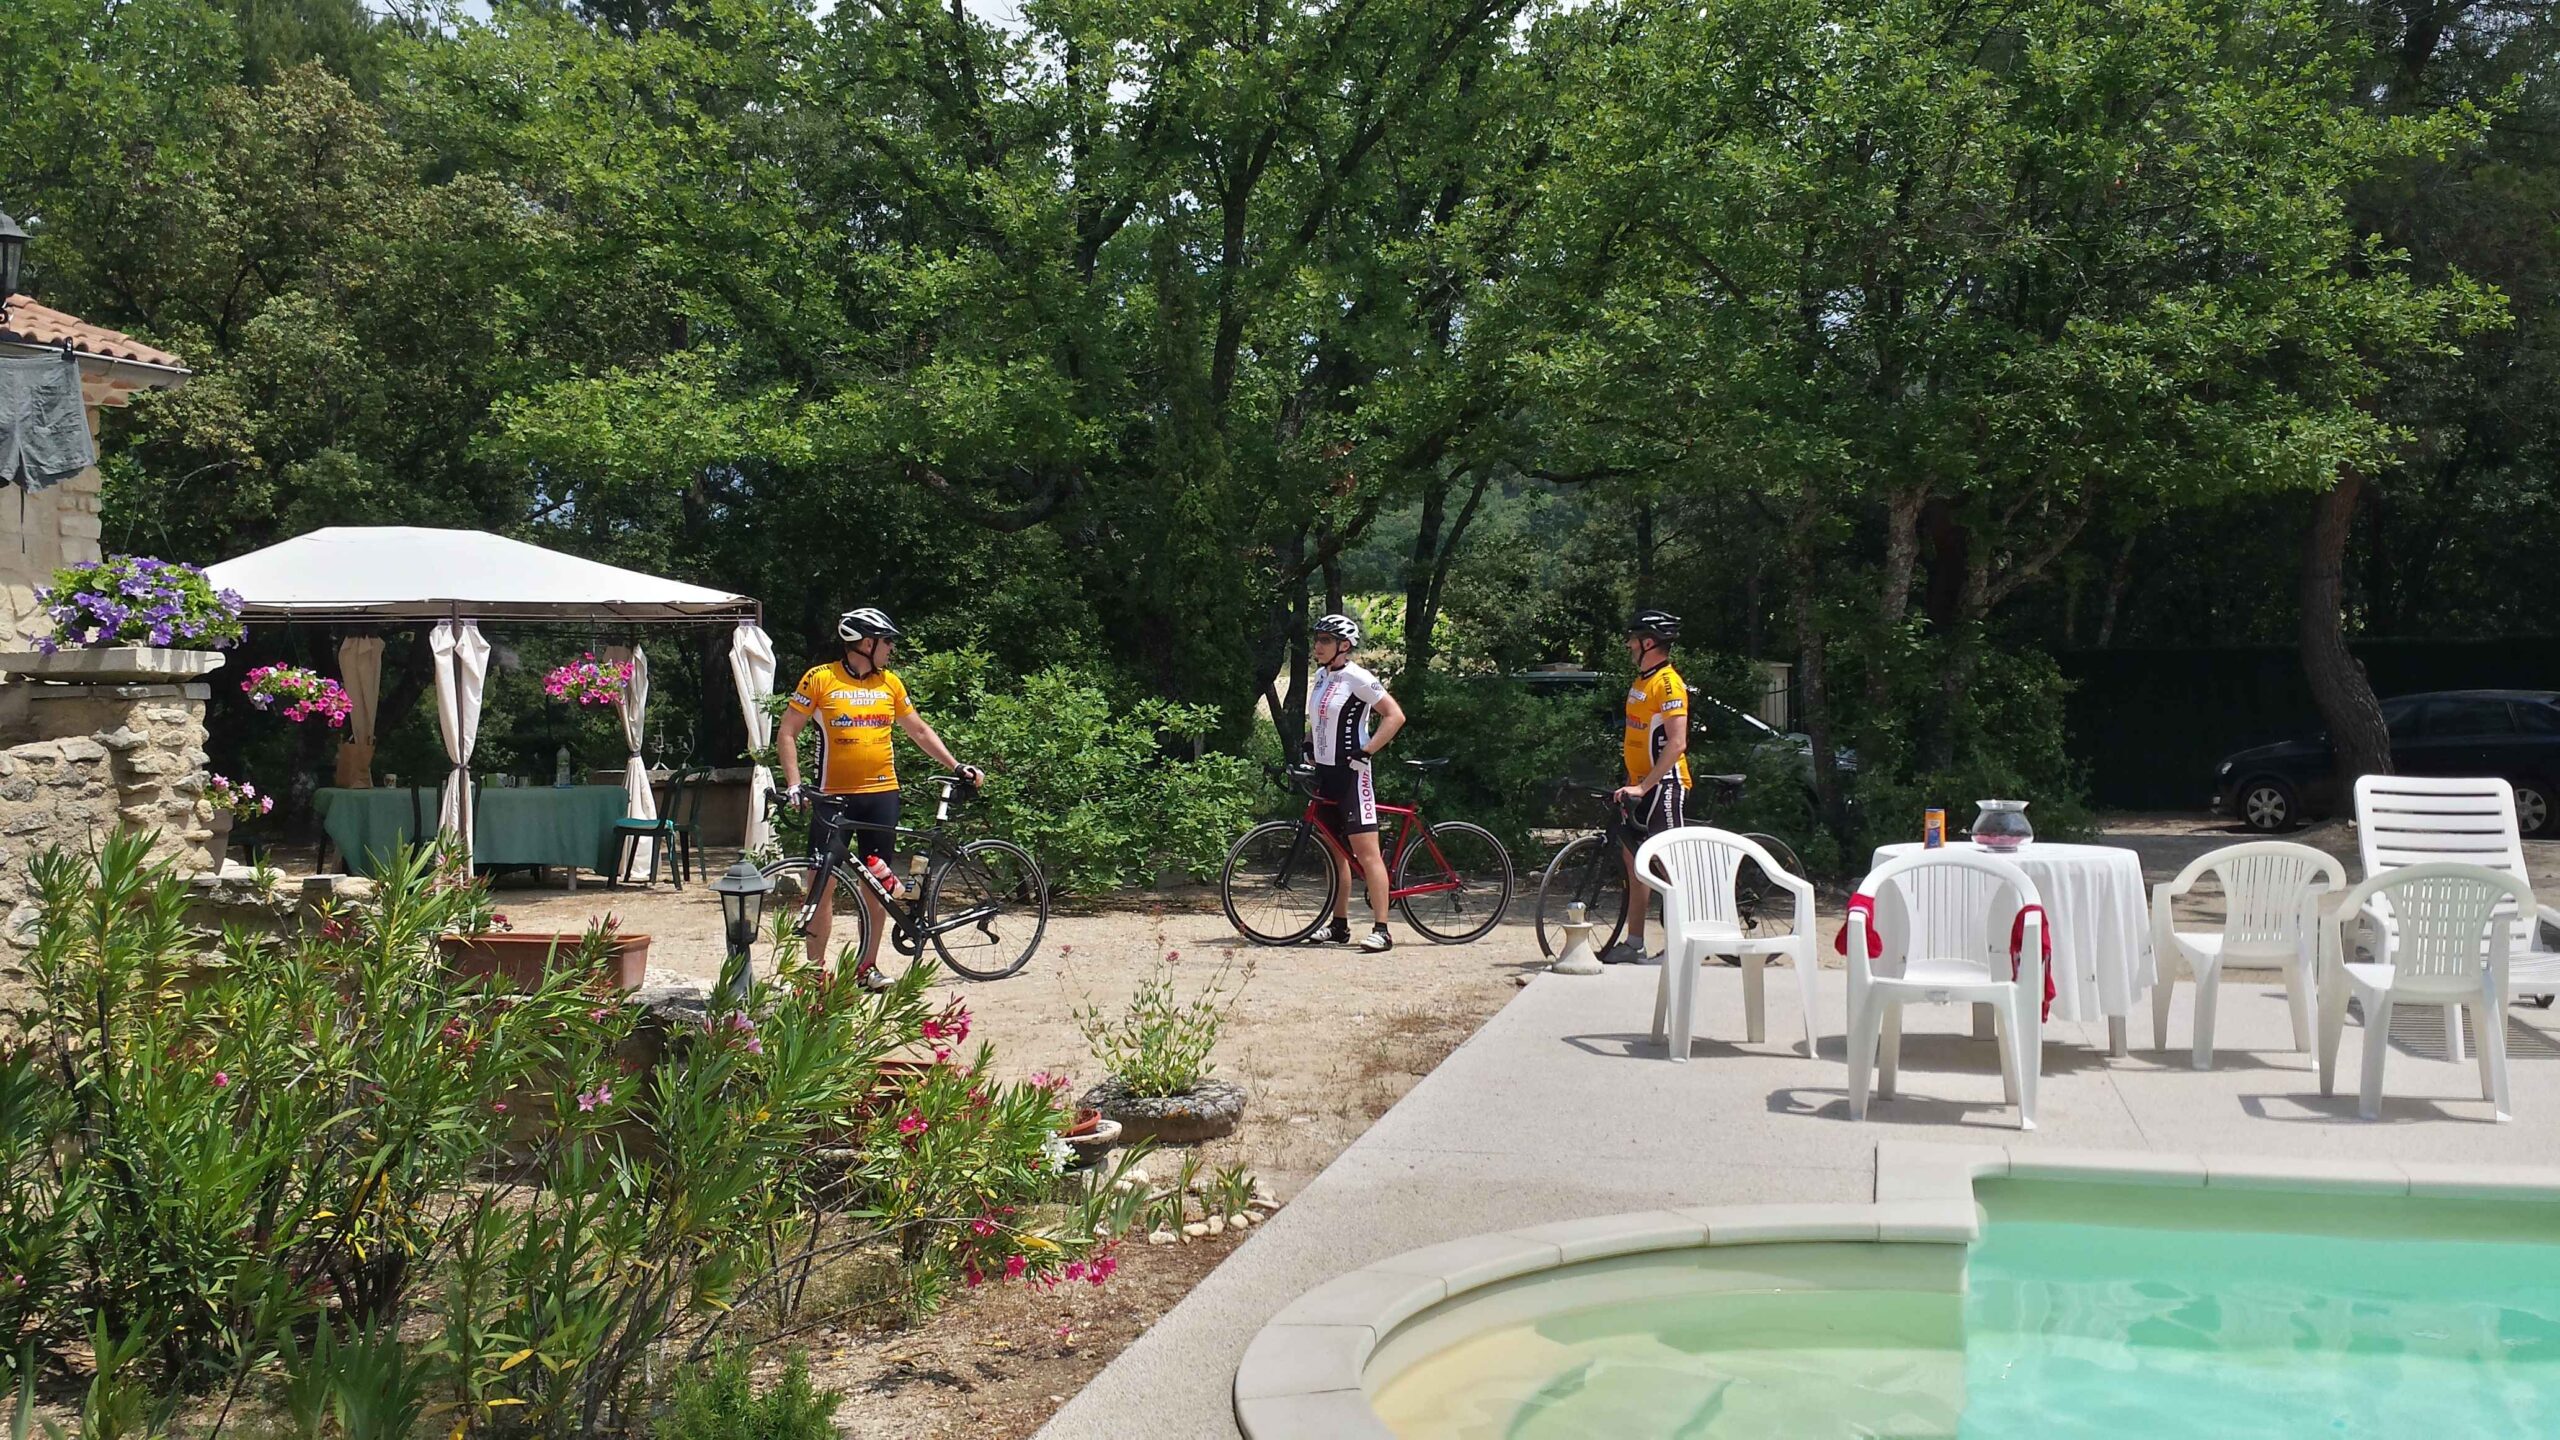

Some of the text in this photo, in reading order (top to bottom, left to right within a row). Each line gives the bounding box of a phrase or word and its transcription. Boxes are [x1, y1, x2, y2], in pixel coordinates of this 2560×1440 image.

[831, 690, 888, 700] FINISHER
[848, 698, 878, 706] 2007
[831, 719, 853, 728] tour
[1345, 701, 1361, 750] DOLOMITI
[849, 852, 894, 903] TREK
